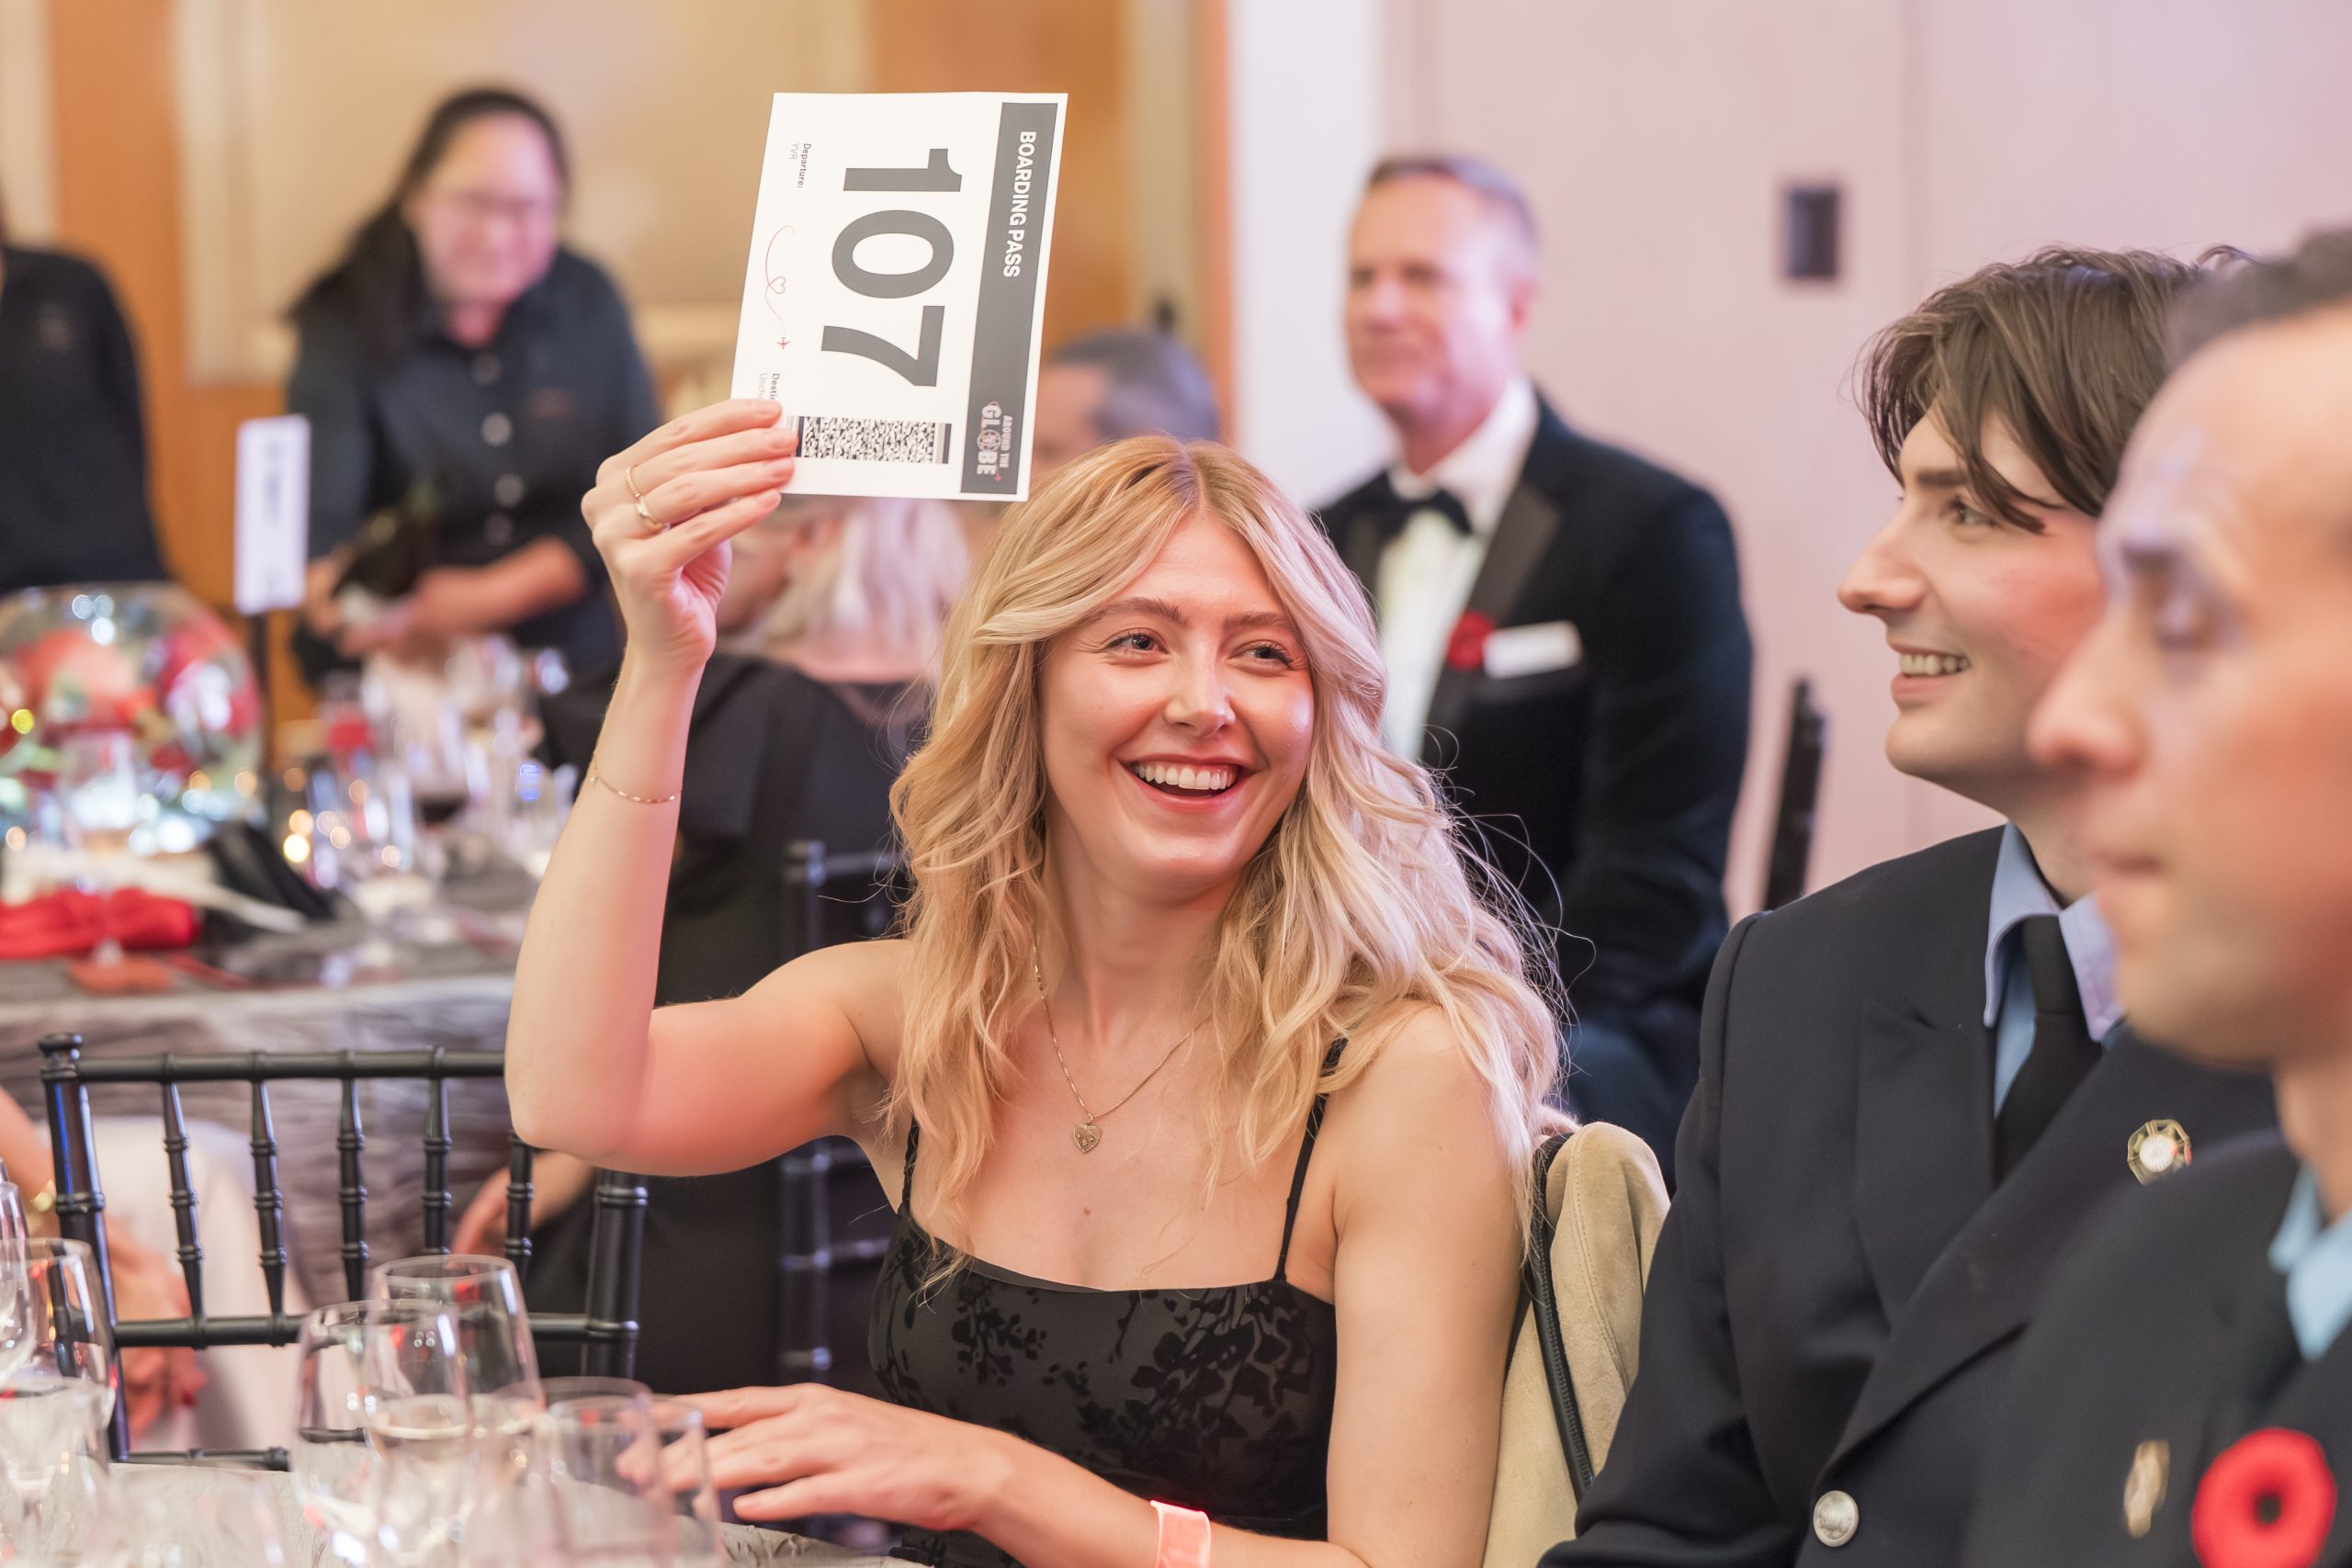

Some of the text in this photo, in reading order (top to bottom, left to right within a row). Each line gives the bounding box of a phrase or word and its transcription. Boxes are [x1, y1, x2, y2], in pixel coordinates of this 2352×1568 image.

[790, 142, 800, 160] YVR
[797, 143, 812, 188] Departure:
[1002, 131, 1037, 277] BOARDING PASS
[821, 148, 963, 387] 107
[999, 415, 1013, 468] AROUND THE
